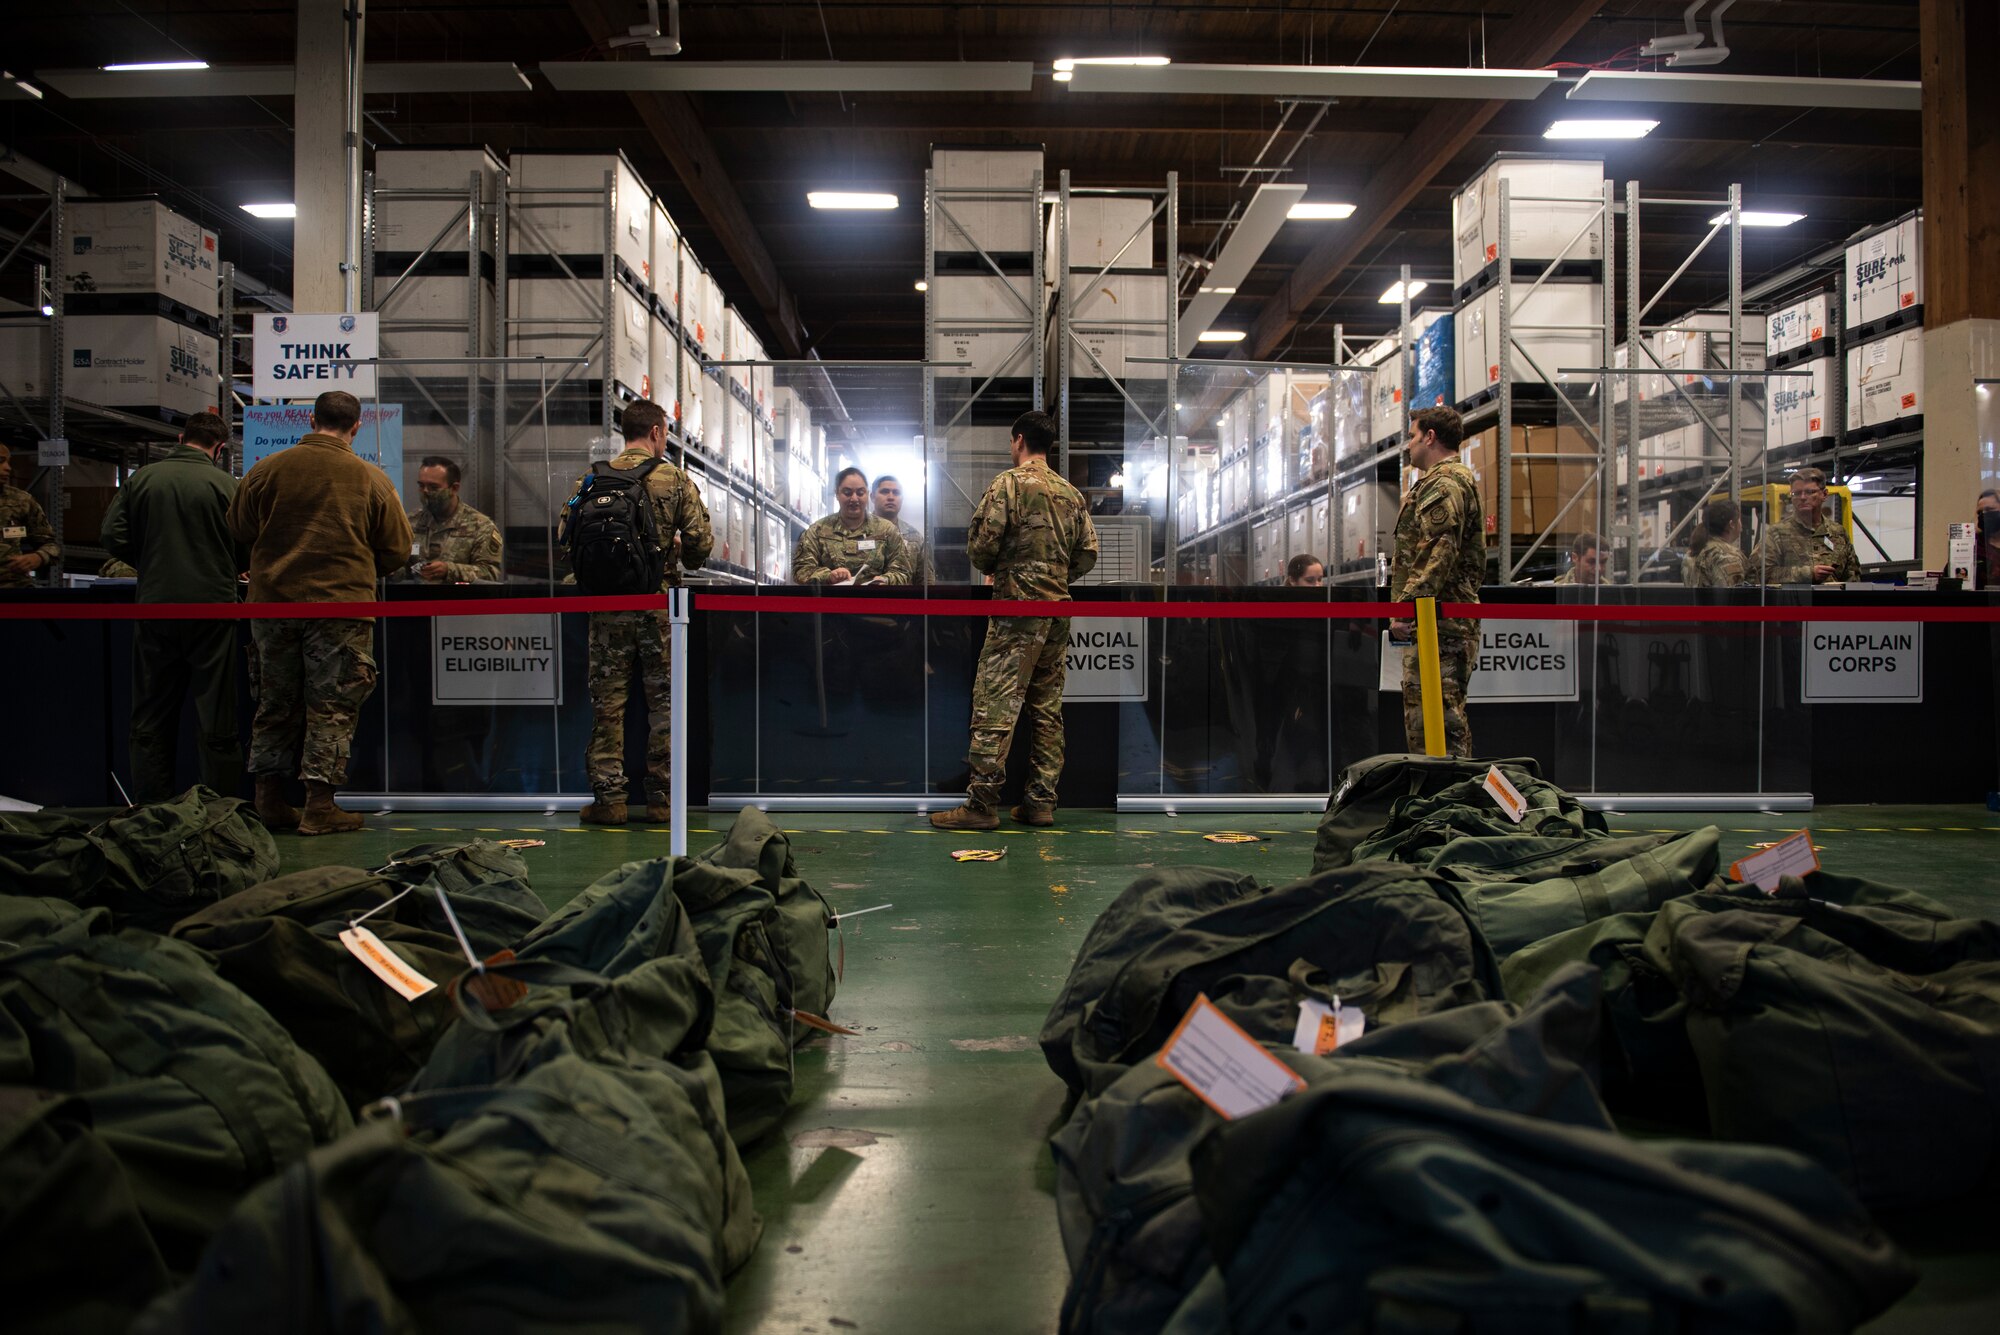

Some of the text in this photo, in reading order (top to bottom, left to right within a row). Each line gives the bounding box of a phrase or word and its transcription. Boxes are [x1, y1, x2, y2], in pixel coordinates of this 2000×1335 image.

[281, 344, 351, 359] THINK
[75, 357, 91, 366] GSA
[94, 357, 146, 365] Contract Holder
[273, 364, 358, 380] SAFETY
[246, 410, 263, 419] Are
[265, 410, 282, 421] you
[284, 408, 312, 419] REALL
[255, 436, 269, 446] Do
[271, 438, 288, 448] you
[441, 636, 553, 651] PERSONNEL
[1067, 631, 1139, 648] ANCIAL
[1482, 633, 1550, 649] LEGAL
[1813, 635, 1912, 650] CHAPLAIN
[446, 658, 549, 672] ELIGIBILITY
[1065, 654, 1135, 670] RVICES
[1829, 656, 1897, 673] CORPS
